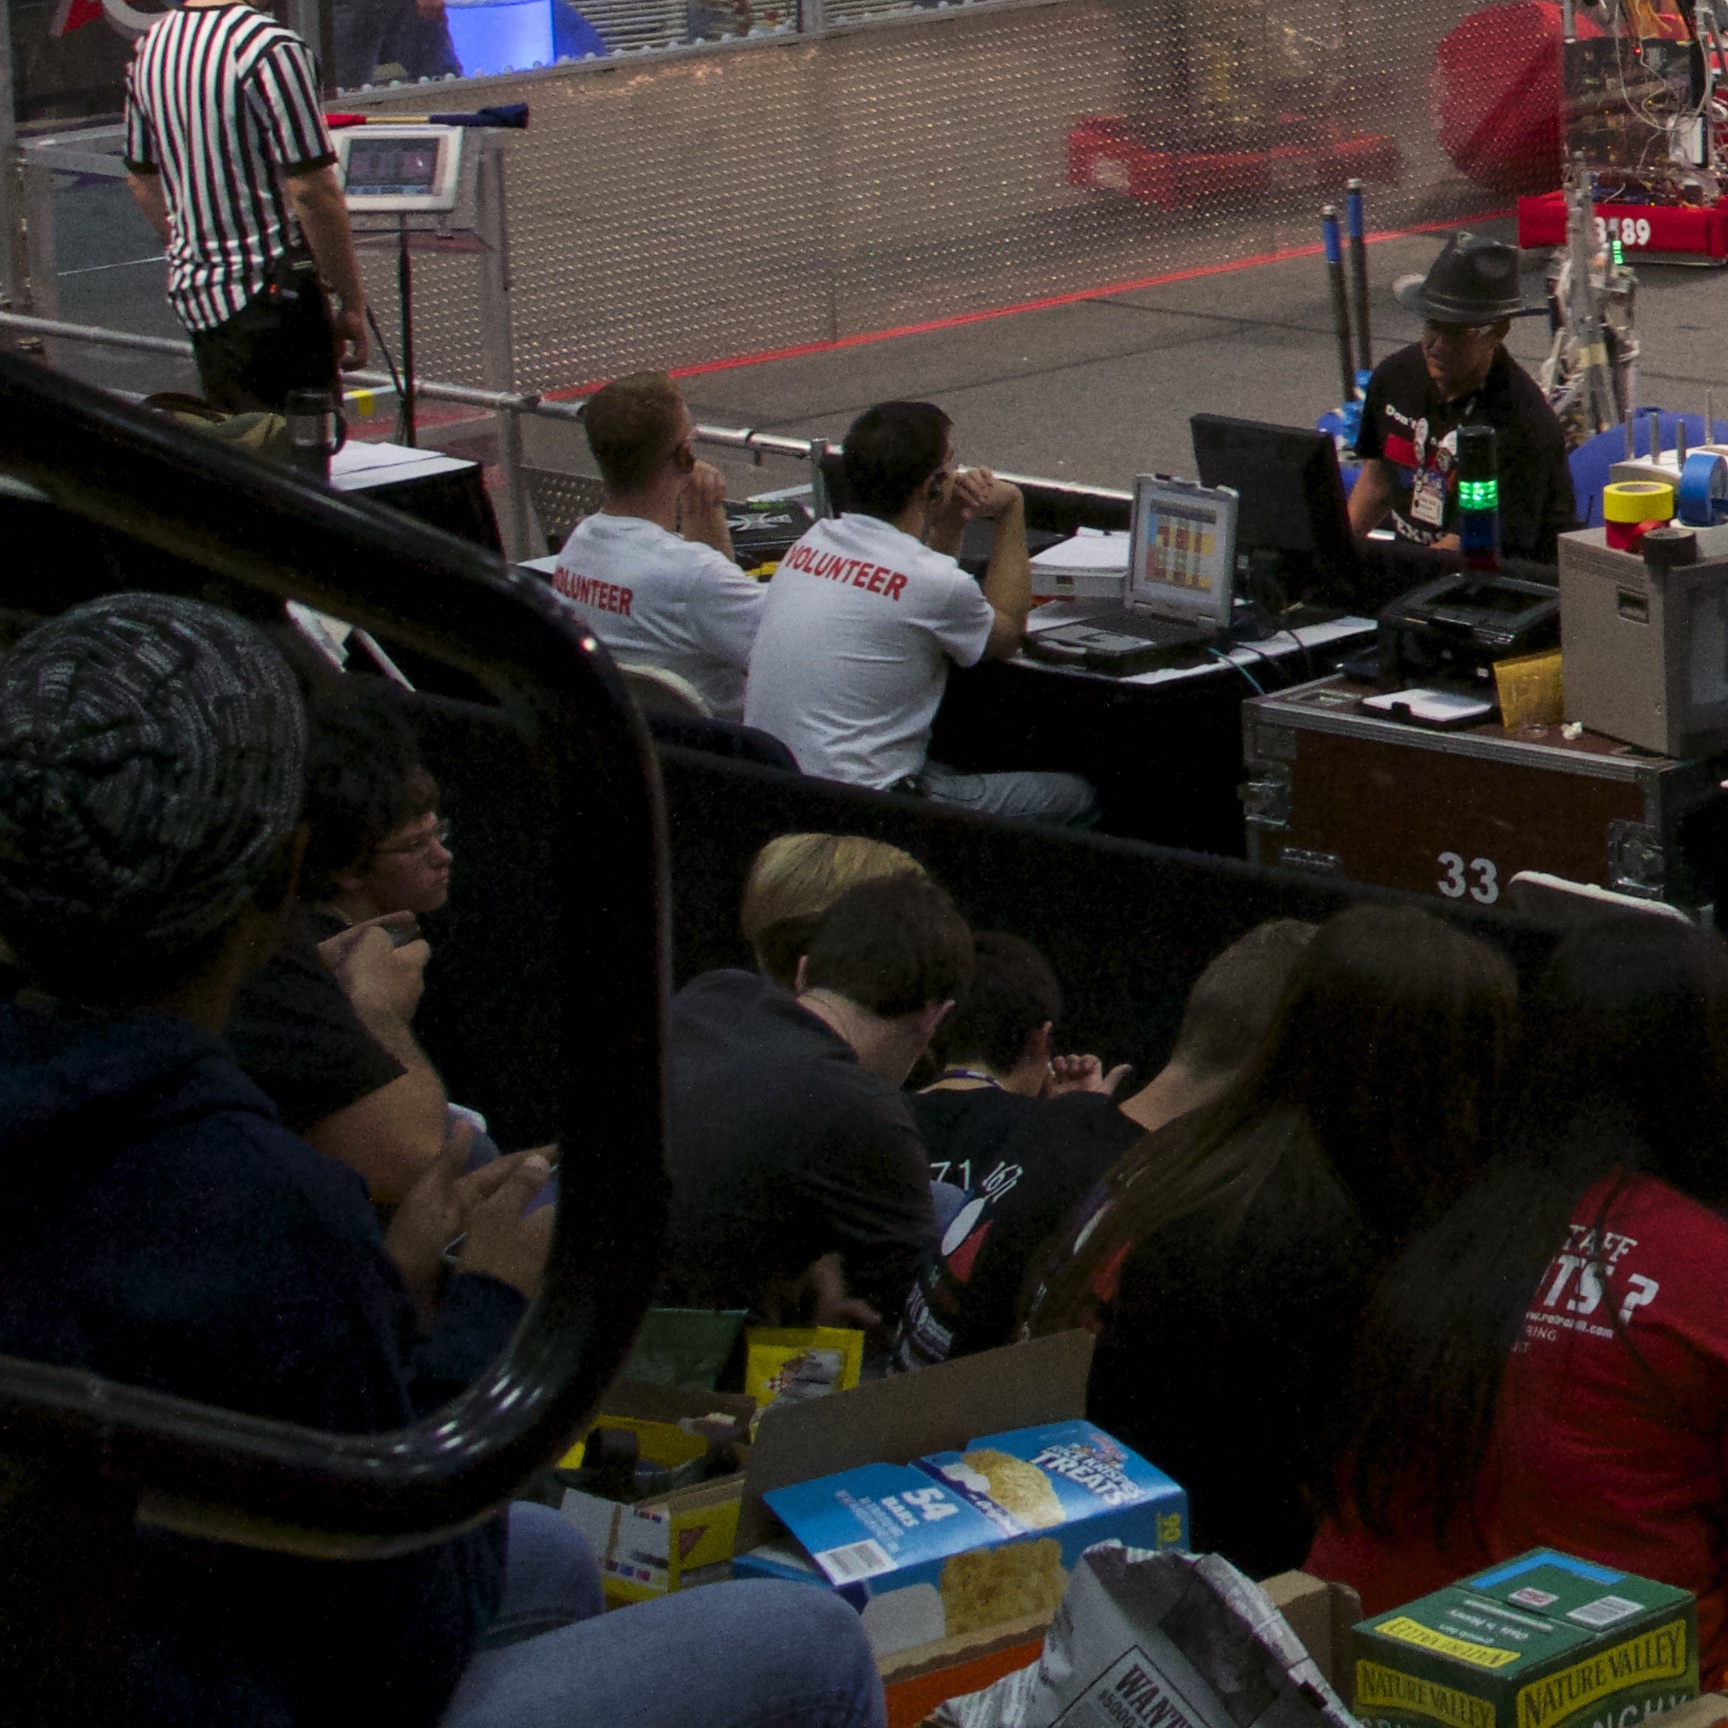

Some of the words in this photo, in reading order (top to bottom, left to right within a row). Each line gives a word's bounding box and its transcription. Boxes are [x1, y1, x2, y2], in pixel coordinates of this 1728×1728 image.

[785, 543, 908, 602] VOLUNTEER
[1436, 850, 1500, 905] 33
[1562, 1223, 1639, 1263] TAFF
[901, 1486, 960, 1522] 54
[1029, 1451, 1126, 1506] TREATS
[880, 1495, 921, 1528] BARS
[1523, 1655, 1608, 1725] NATURE
[1608, 1624, 1683, 1679] VALLEY
